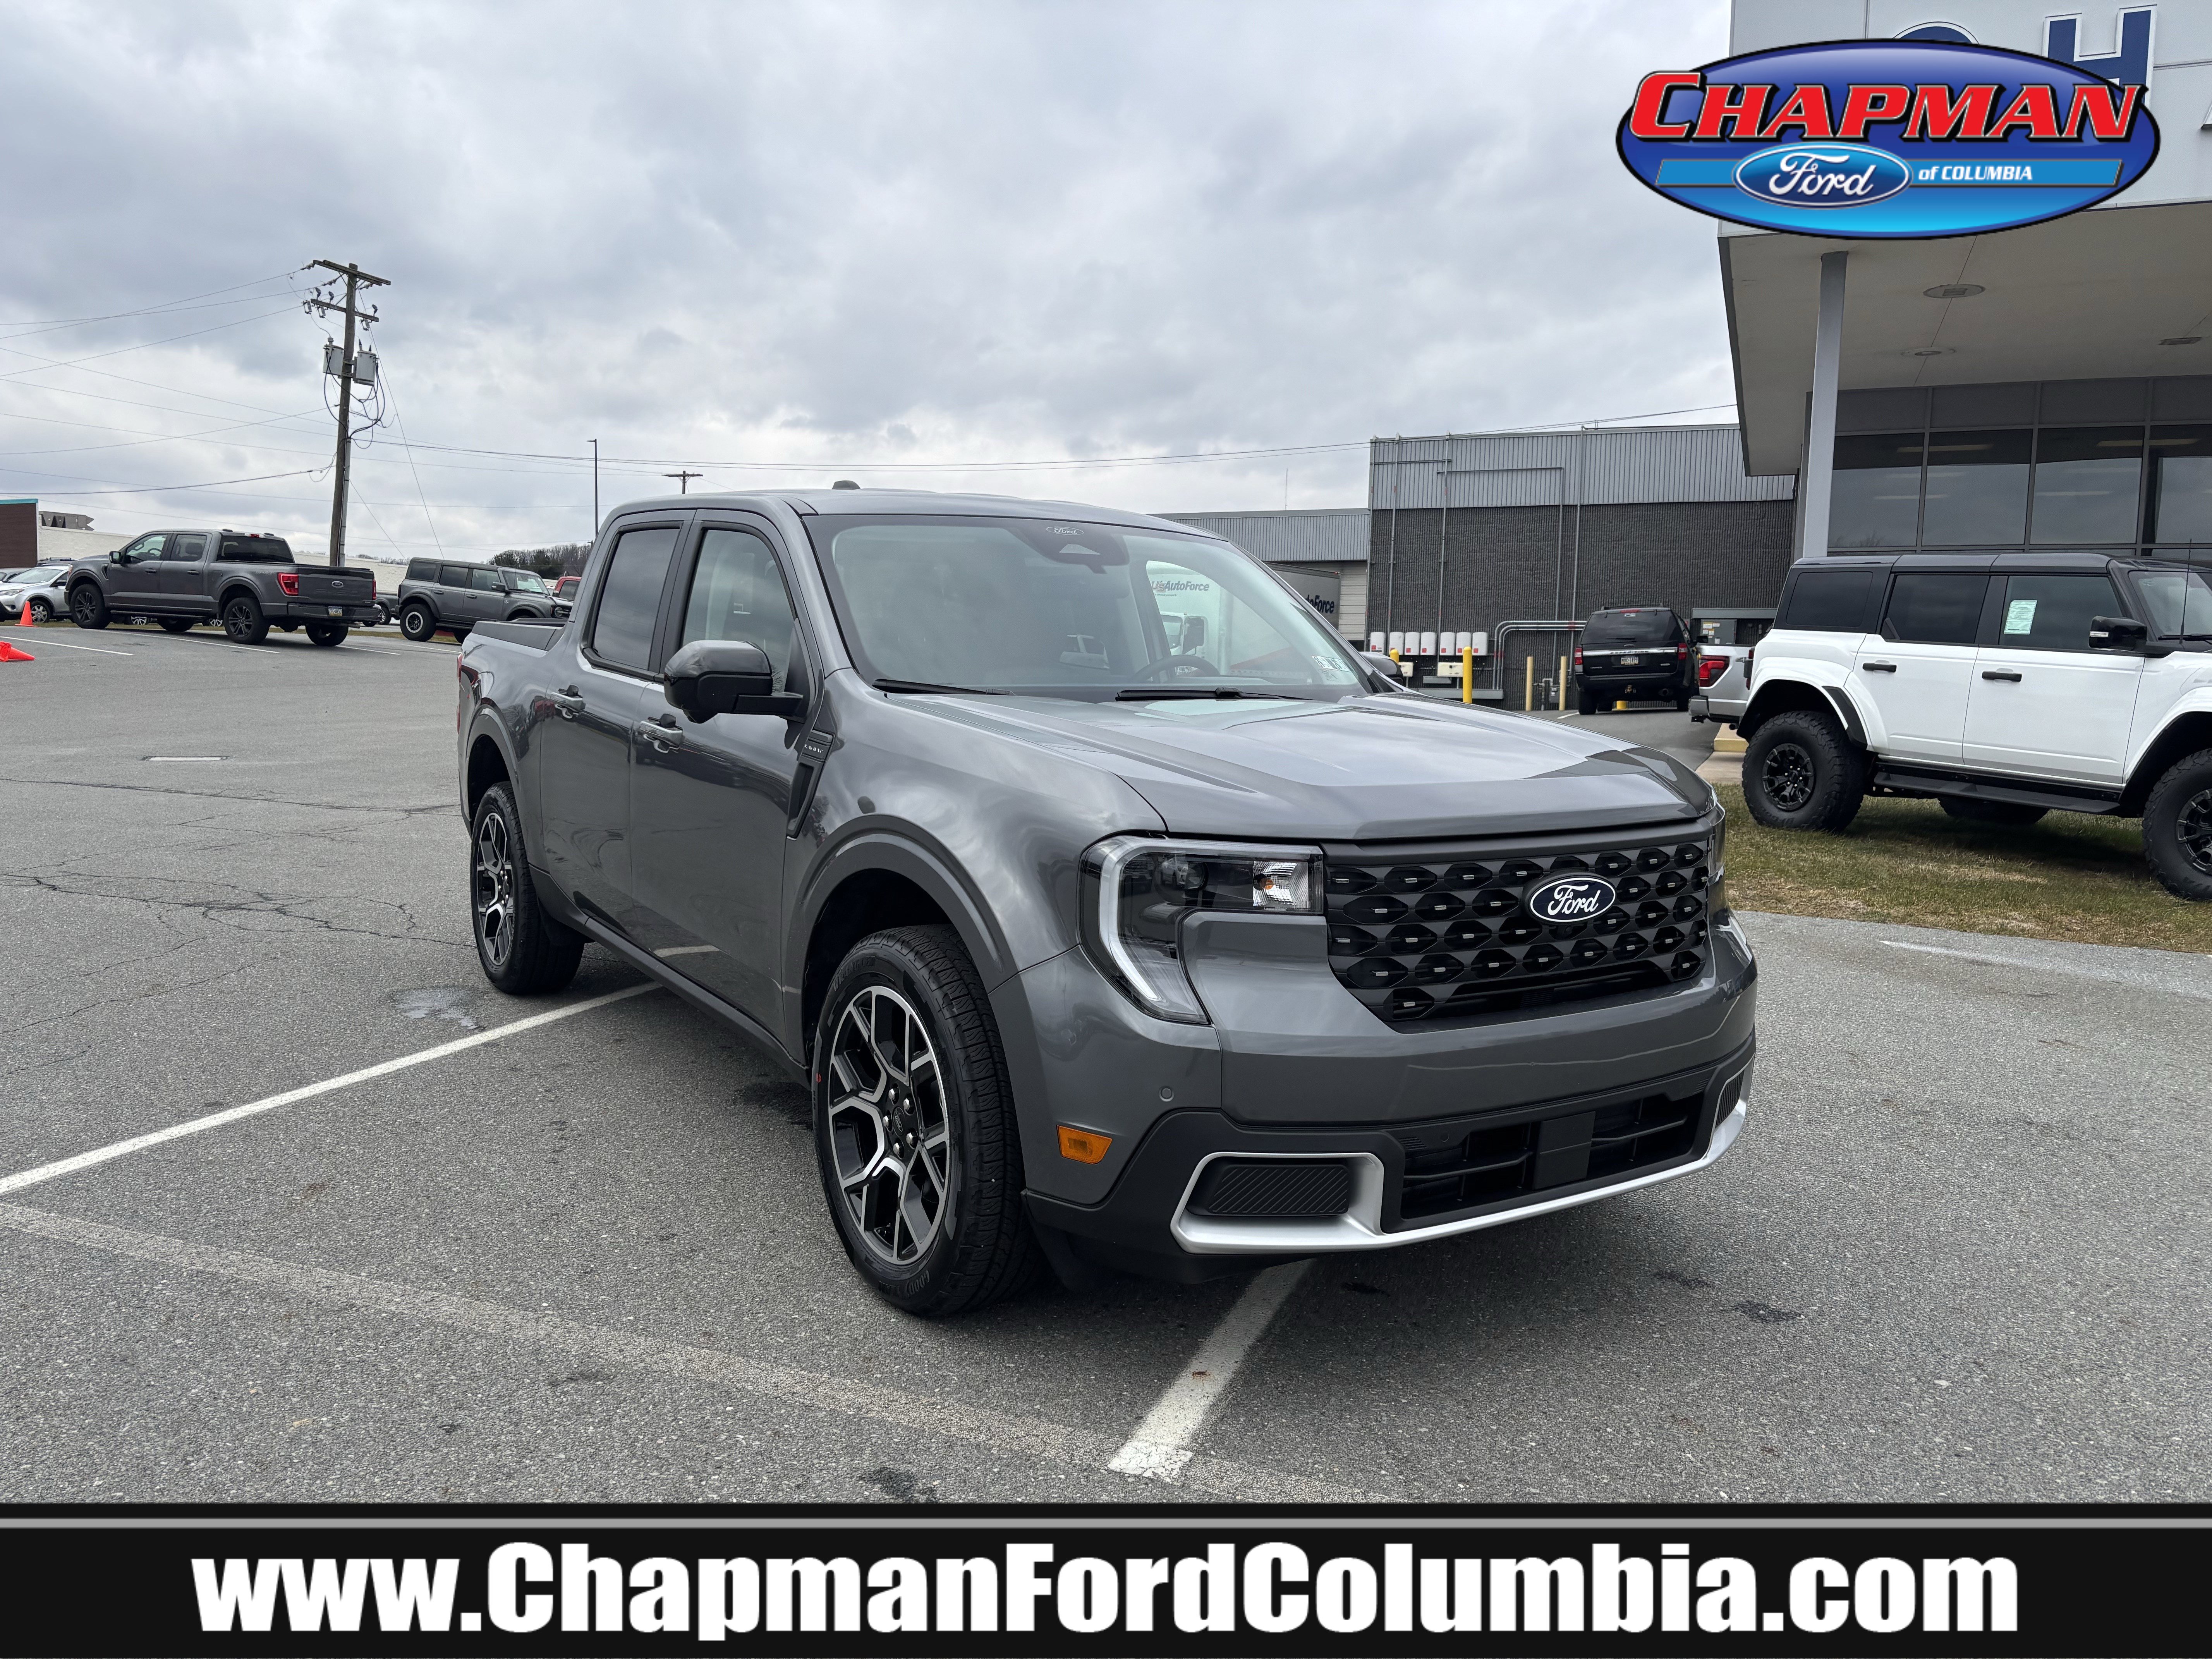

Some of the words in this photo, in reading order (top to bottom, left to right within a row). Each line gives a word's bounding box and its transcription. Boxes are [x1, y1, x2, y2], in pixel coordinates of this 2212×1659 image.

[1164, 580, 1209, 591] AutoForce
[1305, 594, 1334, 614] toForce
[1548, 884, 1601, 915] Ford
